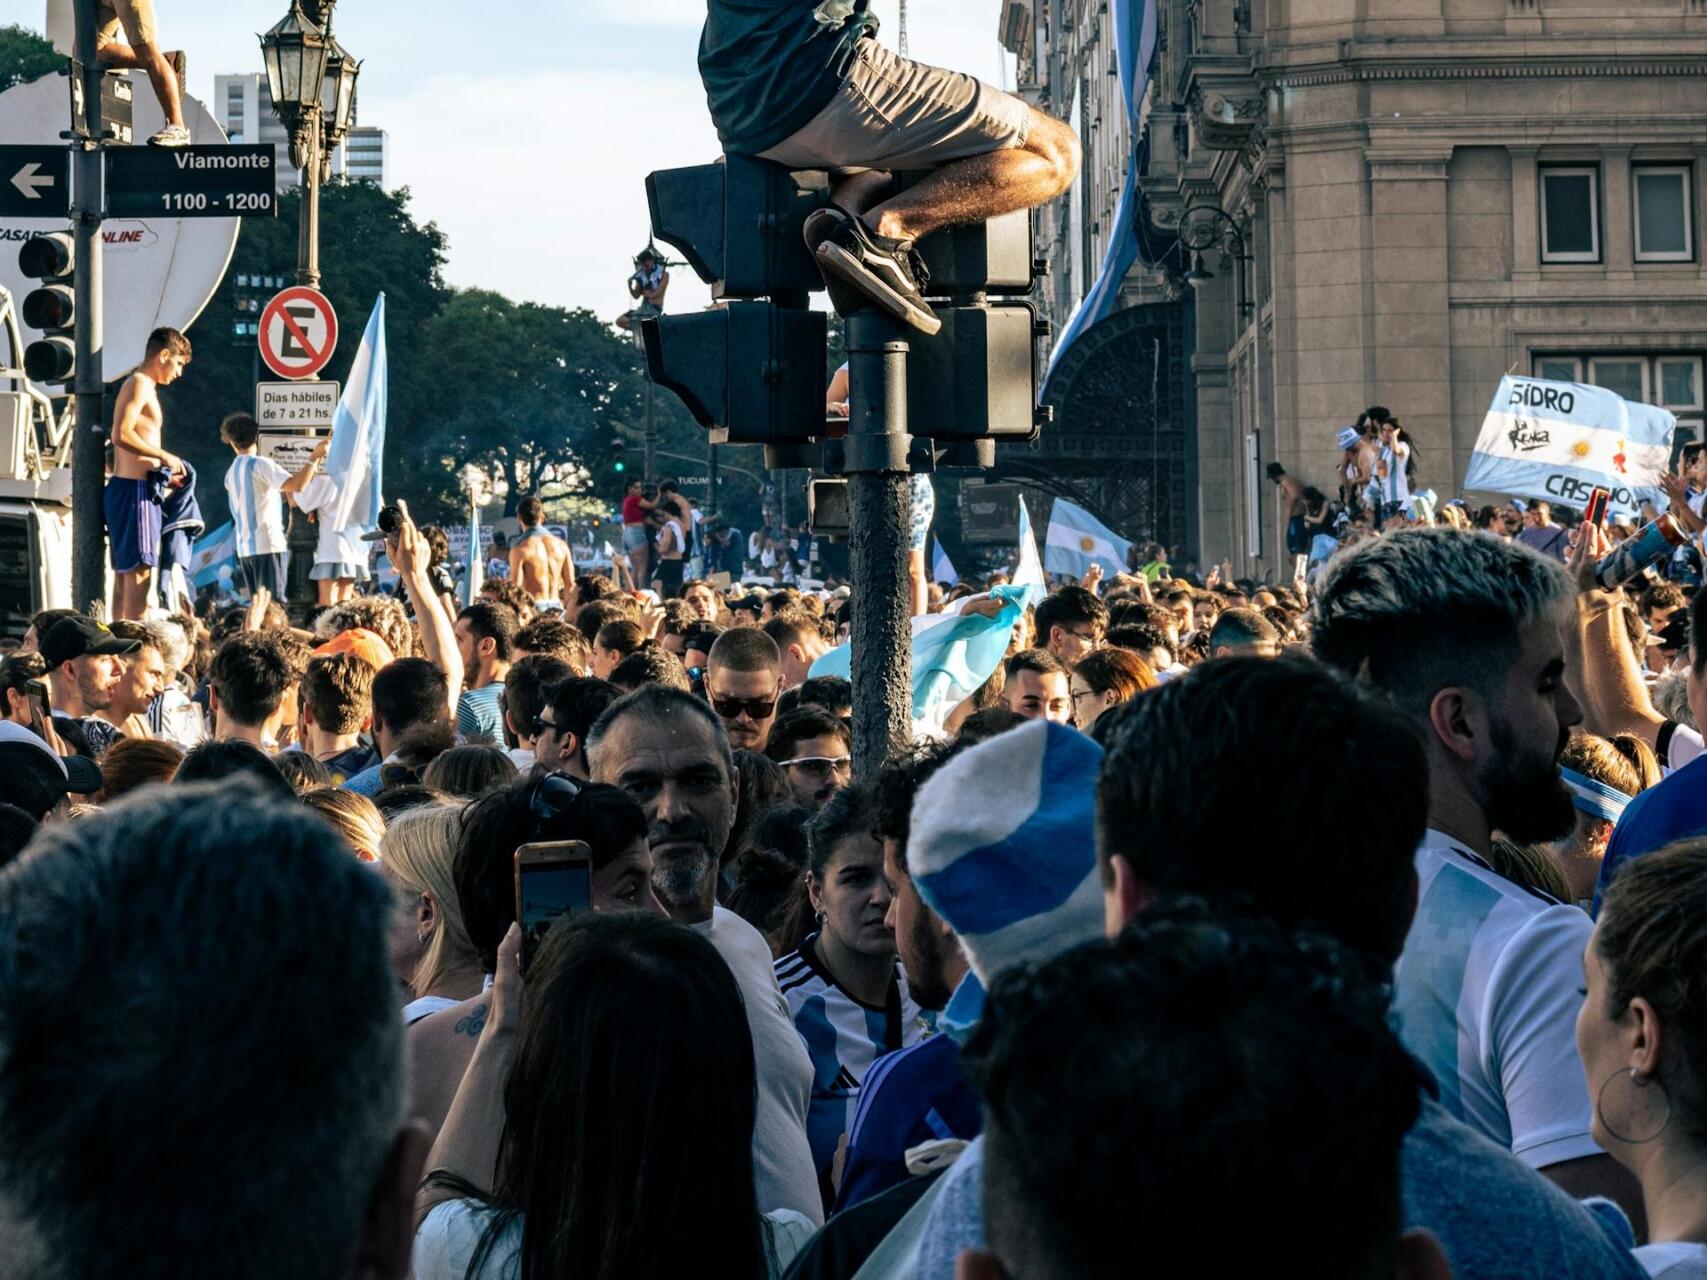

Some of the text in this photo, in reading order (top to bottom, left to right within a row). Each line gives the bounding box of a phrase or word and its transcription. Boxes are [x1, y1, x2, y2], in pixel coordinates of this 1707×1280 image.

[173, 151, 271, 170] Viamonte
[161, 192, 208, 211] 1100
[225, 192, 271, 211] 1200
[262, 408, 277, 419] de
[279, 407, 286, 419] 7
[288, 410, 296, 419] a
[298, 407, 311, 419] 21
[677, 476, 723, 485] TUCUMN
